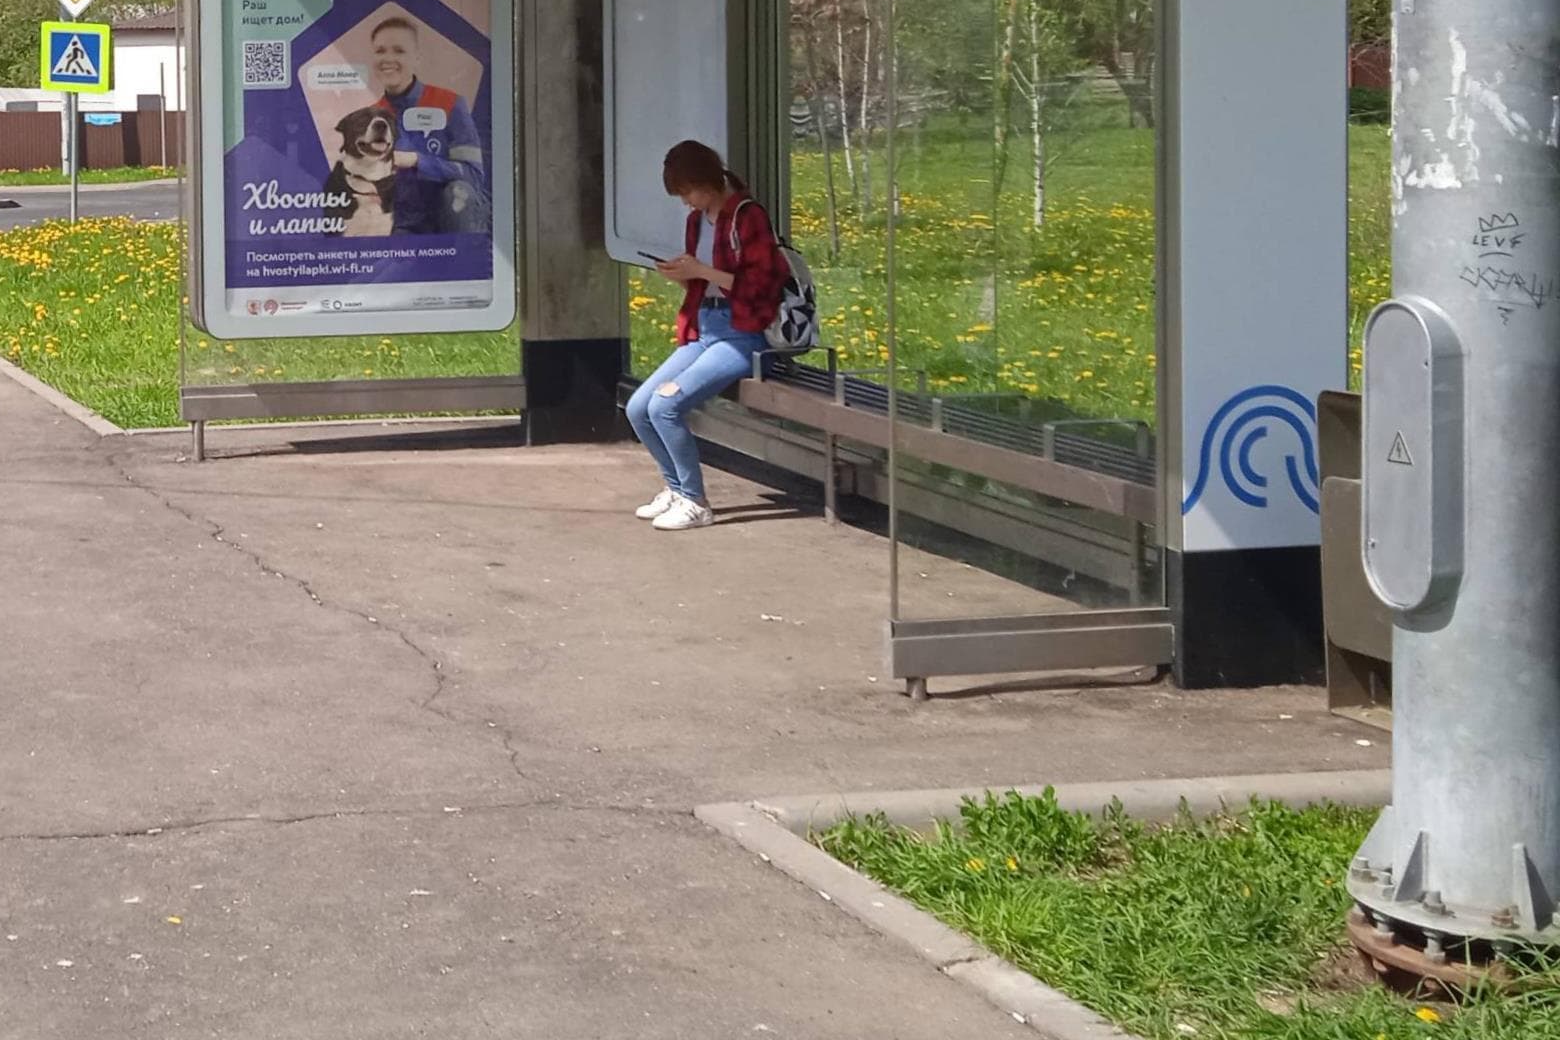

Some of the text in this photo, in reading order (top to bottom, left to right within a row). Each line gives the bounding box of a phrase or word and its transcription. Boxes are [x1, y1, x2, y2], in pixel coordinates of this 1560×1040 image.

[242, 13, 304, 26] ищет дом!
[242, 179, 352, 210] Хвосты
[249, 216, 348, 236] и лапки
[246, 247, 457, 265] Посмотреть анкеты животных можно
[246, 269, 260, 277] на
